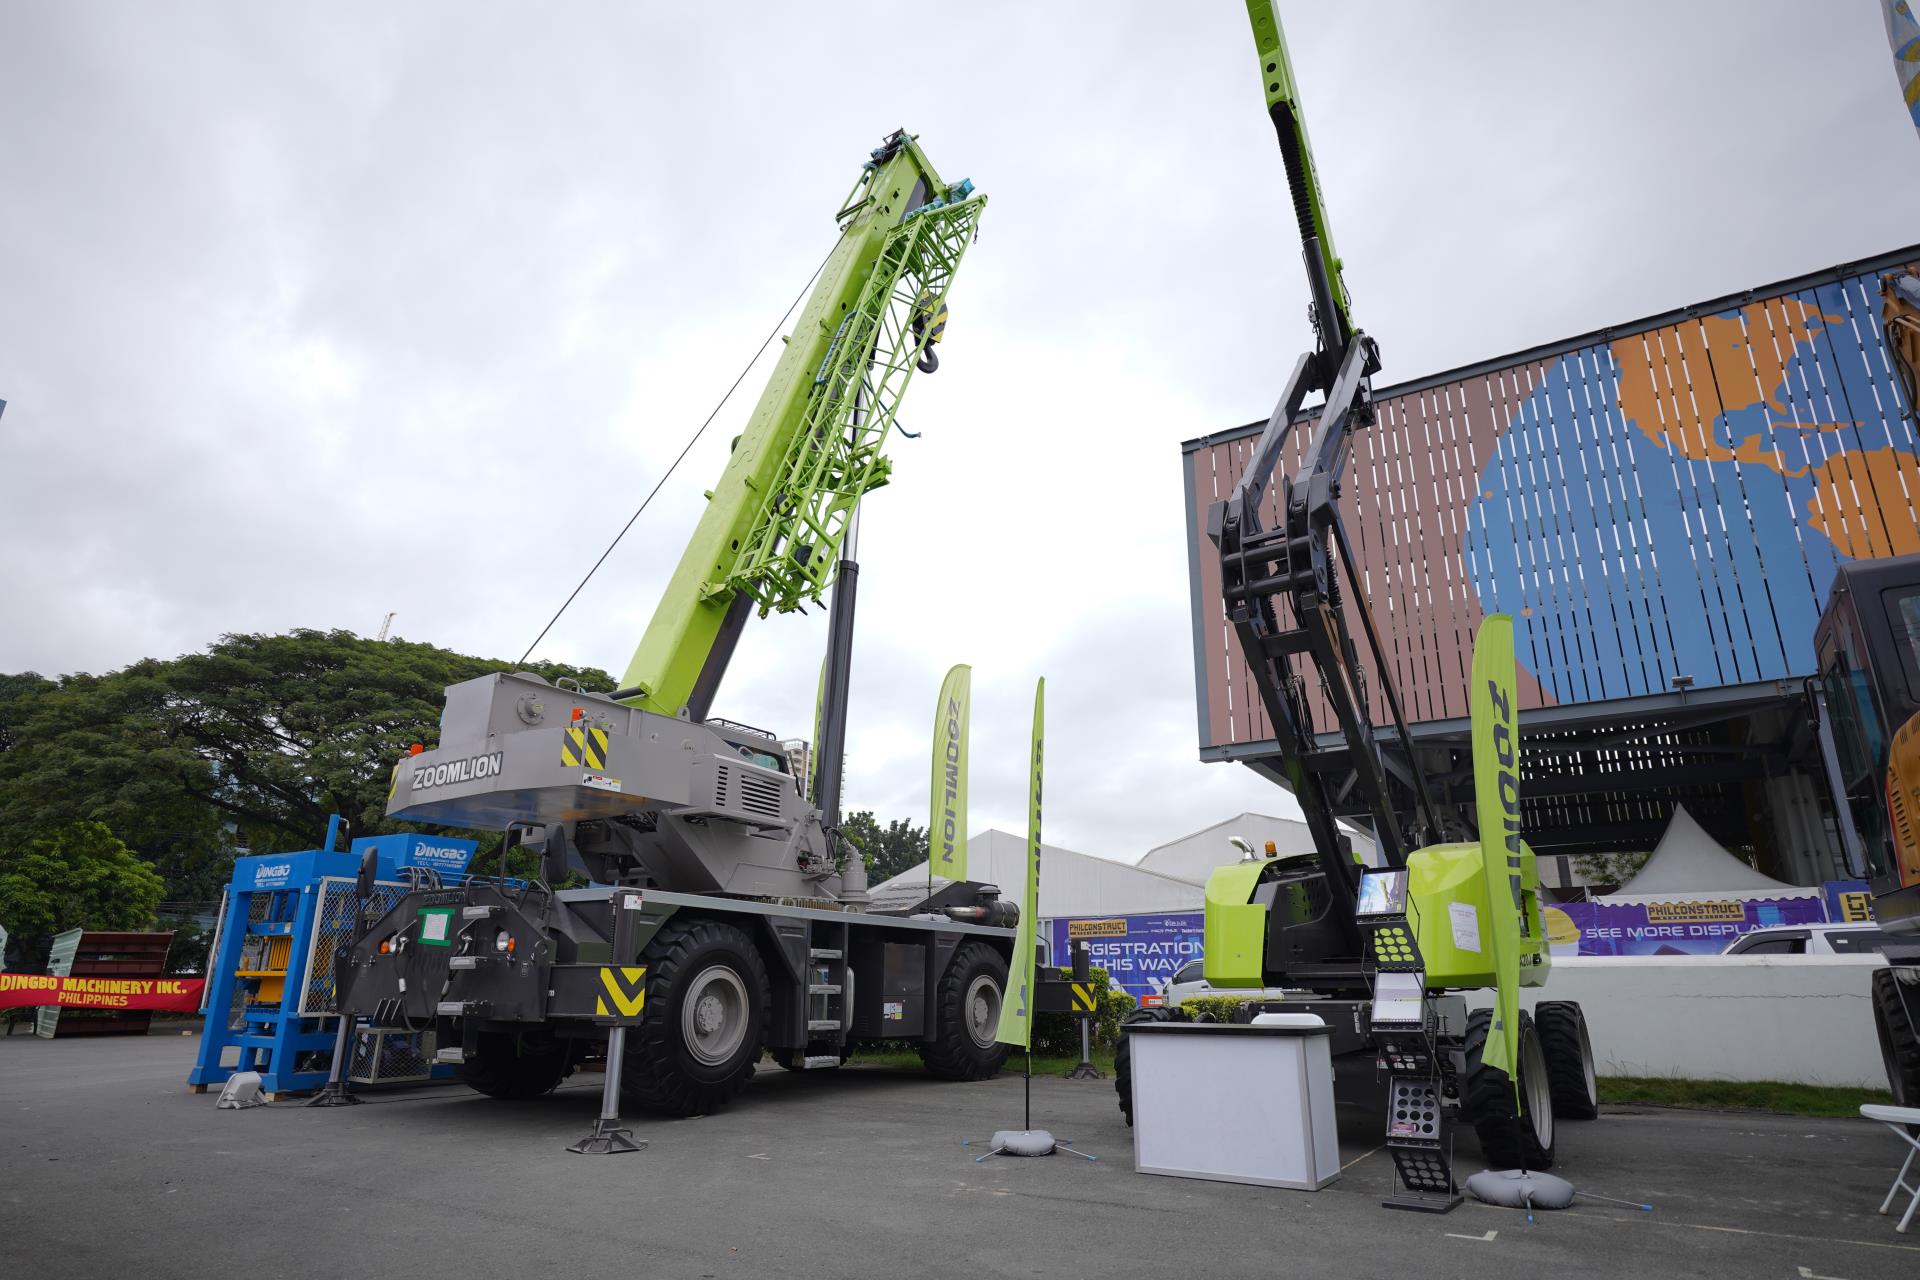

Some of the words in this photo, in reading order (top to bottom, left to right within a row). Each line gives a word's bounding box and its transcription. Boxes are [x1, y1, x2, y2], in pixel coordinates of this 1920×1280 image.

[412, 751, 503, 791] ZOOMLION
[942, 697, 961, 863] ZOOMLION
[414, 842, 467, 860] DINGBO
[256, 863, 290, 878] DINGBO
[1648, 904, 1741, 915] PHILCONSTRUCT
[1070, 922, 1126, 931] PHILCONSTRUCT
[1586, 928, 1622, 938] SEE
[1627, 926, 1684, 937] MORE
[1689, 923, 1786, 936] DISPLA
[1091, 958, 1133, 971] THIS
[1138, 957, 1183, 971] WAY
[0, 975, 57, 990] DINGBO
[63, 977, 153, 994] MACHINERY
[157, 981, 188, 993] INC.
[58, 991, 128, 1006] PHILIPPINES
